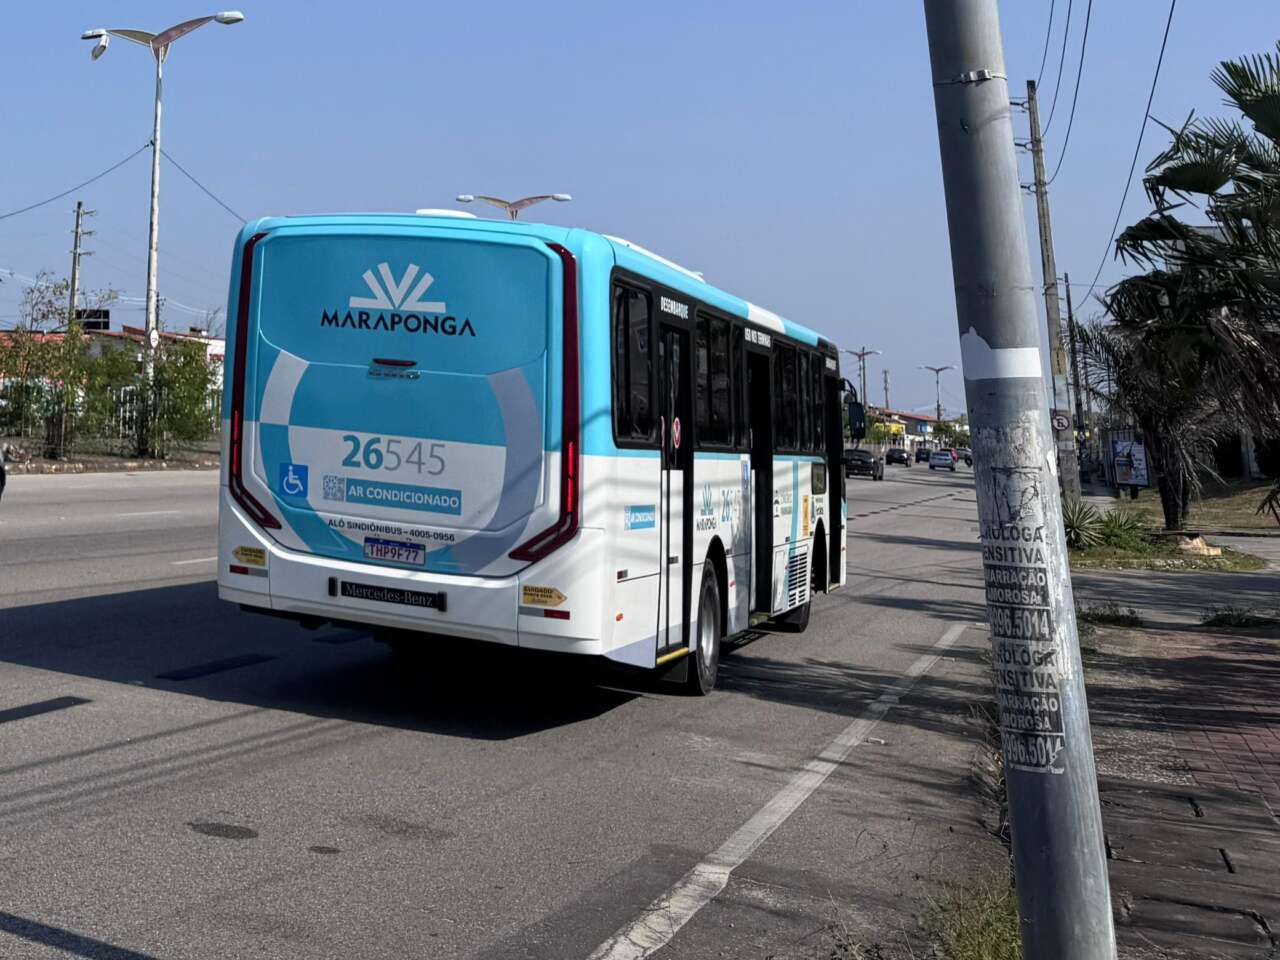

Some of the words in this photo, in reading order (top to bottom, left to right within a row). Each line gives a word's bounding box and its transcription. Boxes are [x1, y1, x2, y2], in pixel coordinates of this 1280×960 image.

[320, 309, 476, 337] MARAPONGA
[341, 434, 446, 476] 26545
[348, 485, 364, 498] AR
[366, 487, 460, 508] CONDICIONADO
[345, 583, 434, 607] Mercedes-Benz
